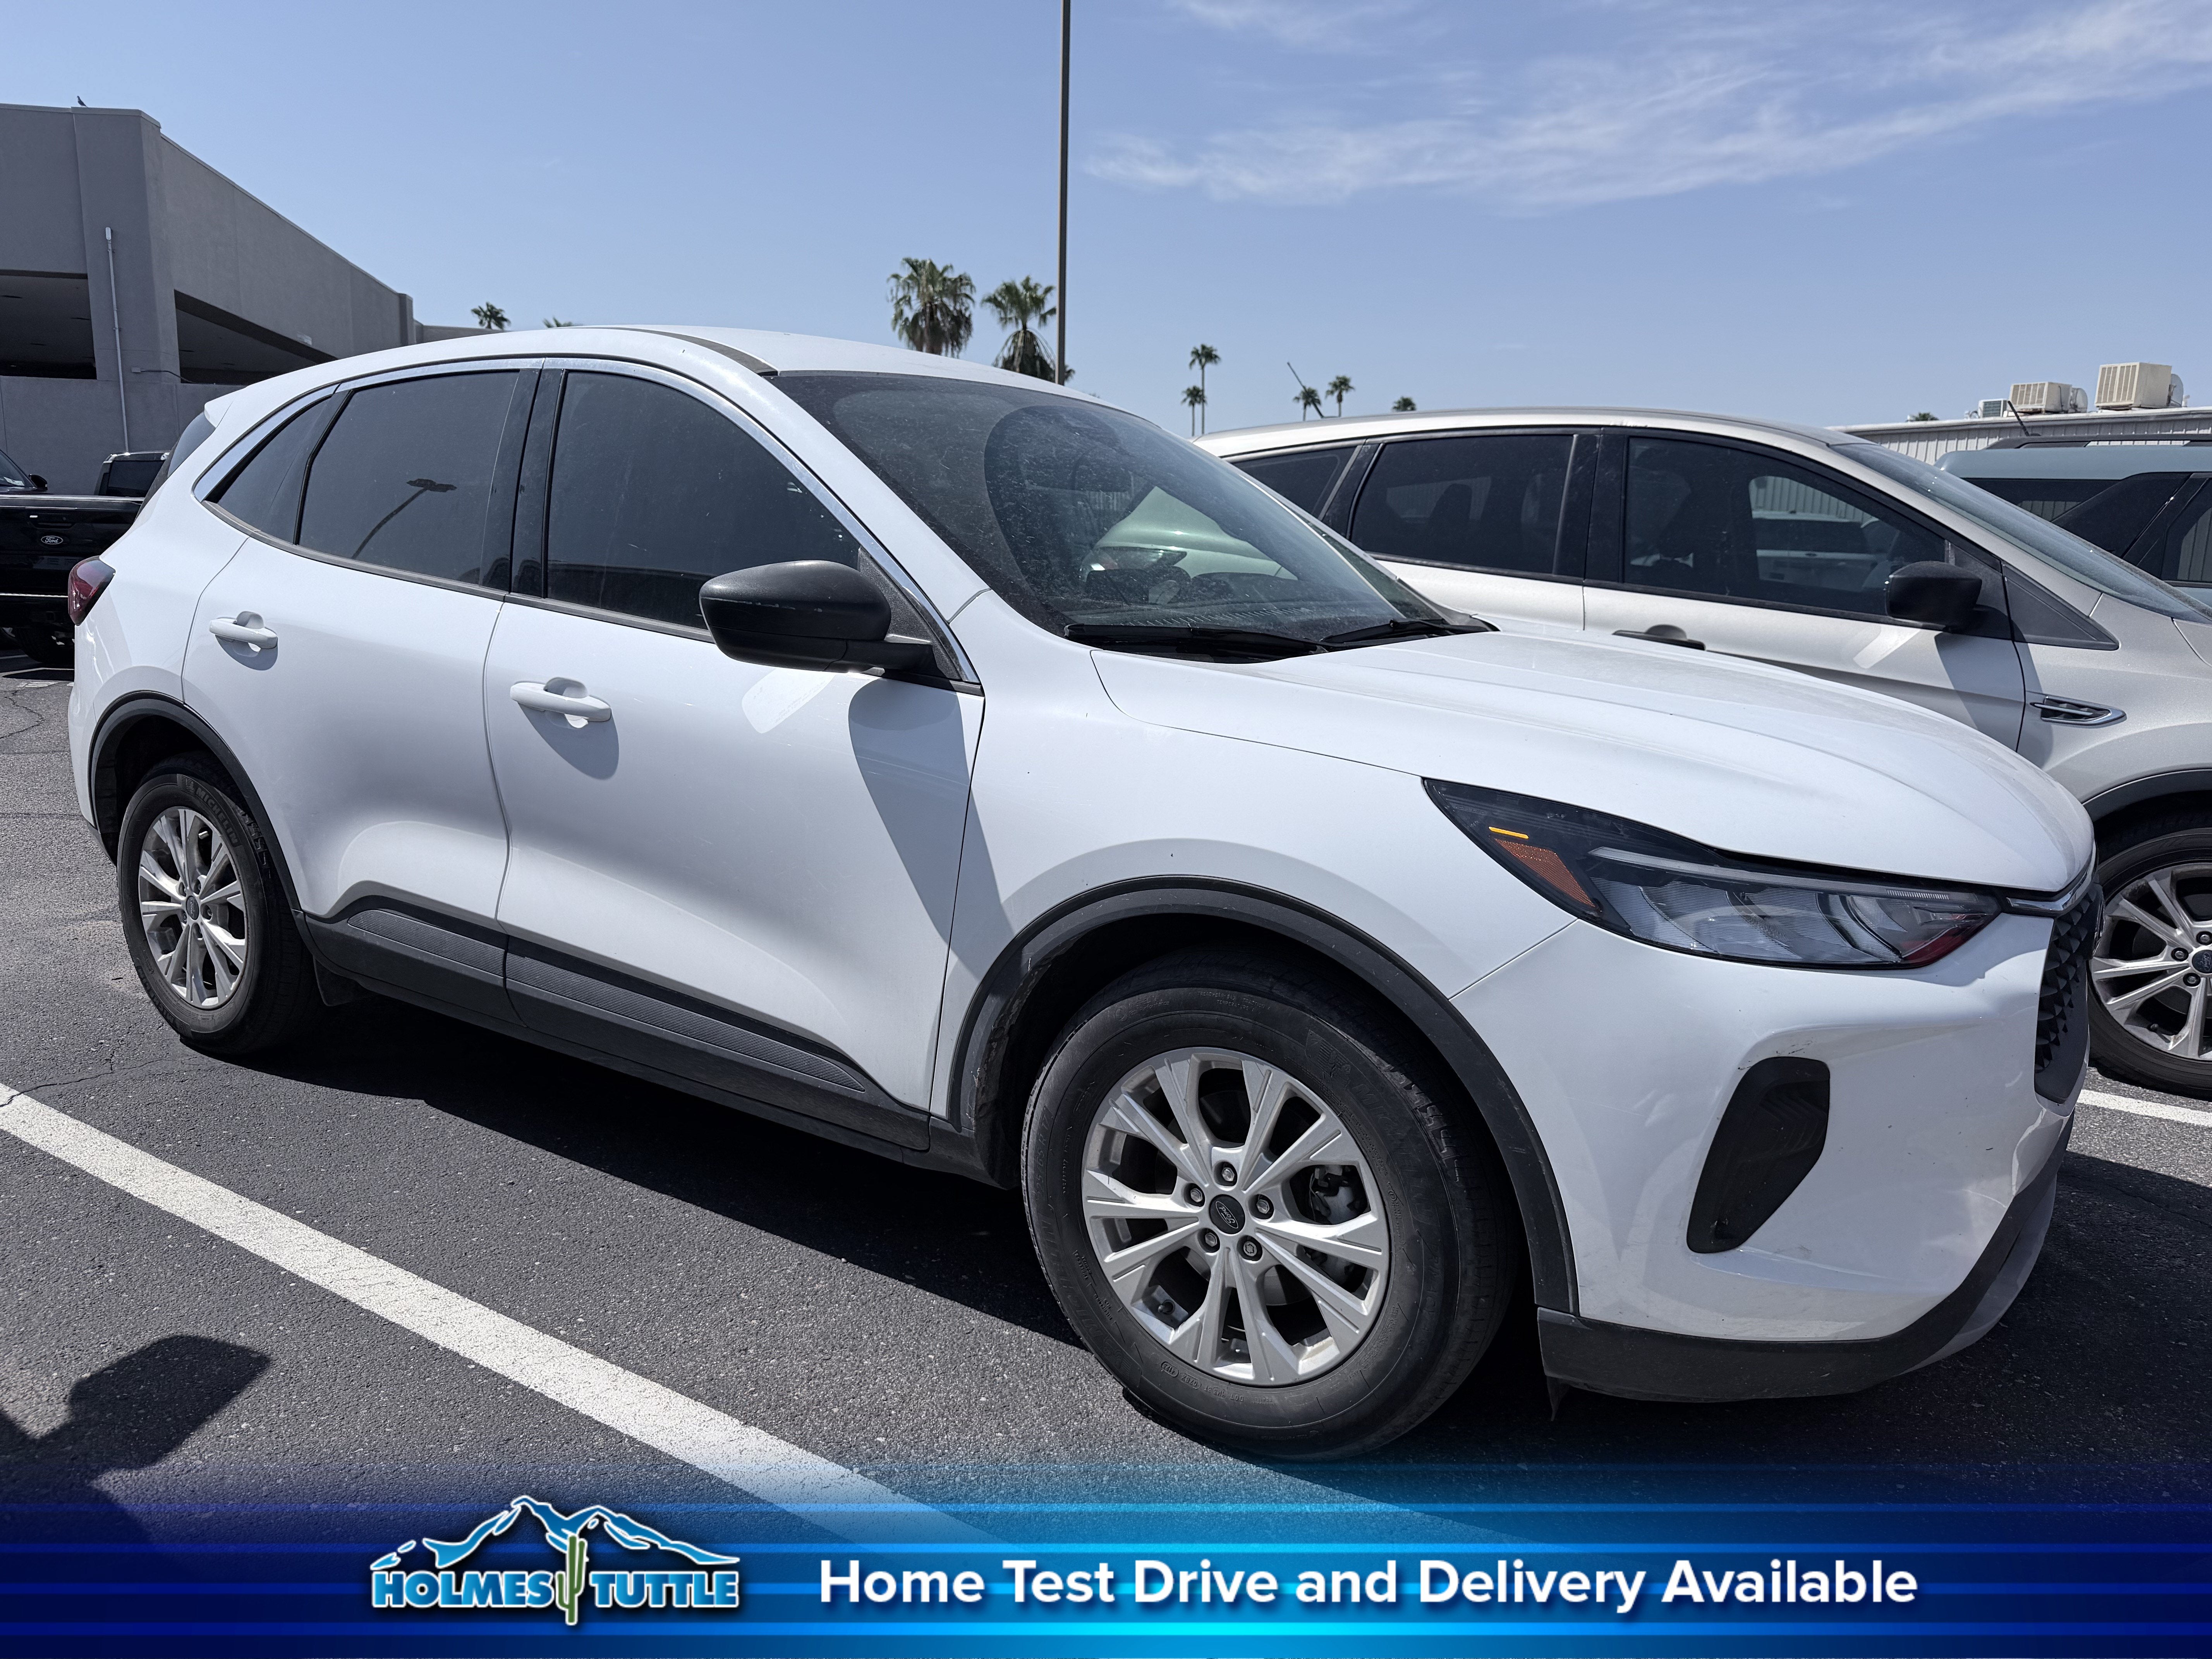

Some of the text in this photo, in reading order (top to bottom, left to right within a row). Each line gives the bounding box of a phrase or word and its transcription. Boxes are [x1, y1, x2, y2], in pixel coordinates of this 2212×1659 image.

[195, 787, 239, 844] MICHELIN
[1219, 1205, 1235, 1224] Ford
[1230, 1393, 1245, 1403] DOT
